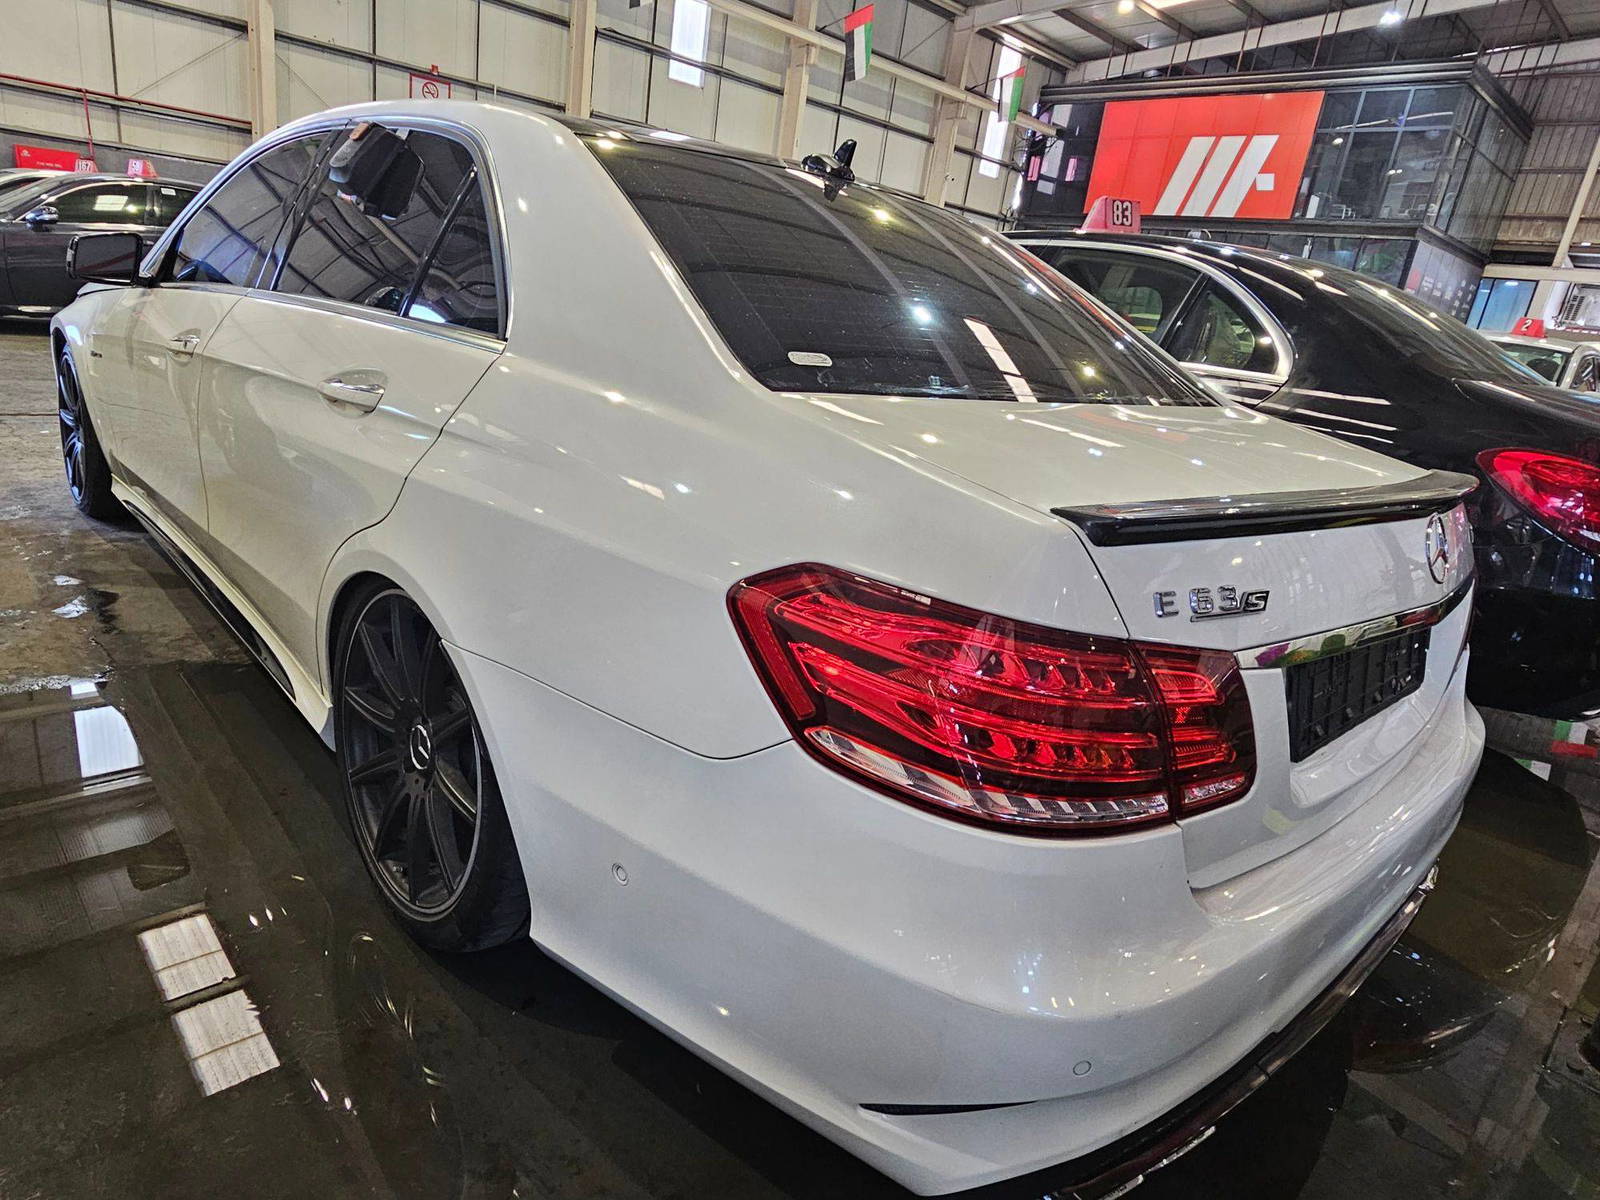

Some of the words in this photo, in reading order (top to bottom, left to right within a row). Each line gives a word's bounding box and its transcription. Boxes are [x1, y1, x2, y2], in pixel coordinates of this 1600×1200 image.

[1113, 200, 1132, 226] 83
[1521, 319, 1533, 332] 2
[1153, 591, 1179, 618] E
